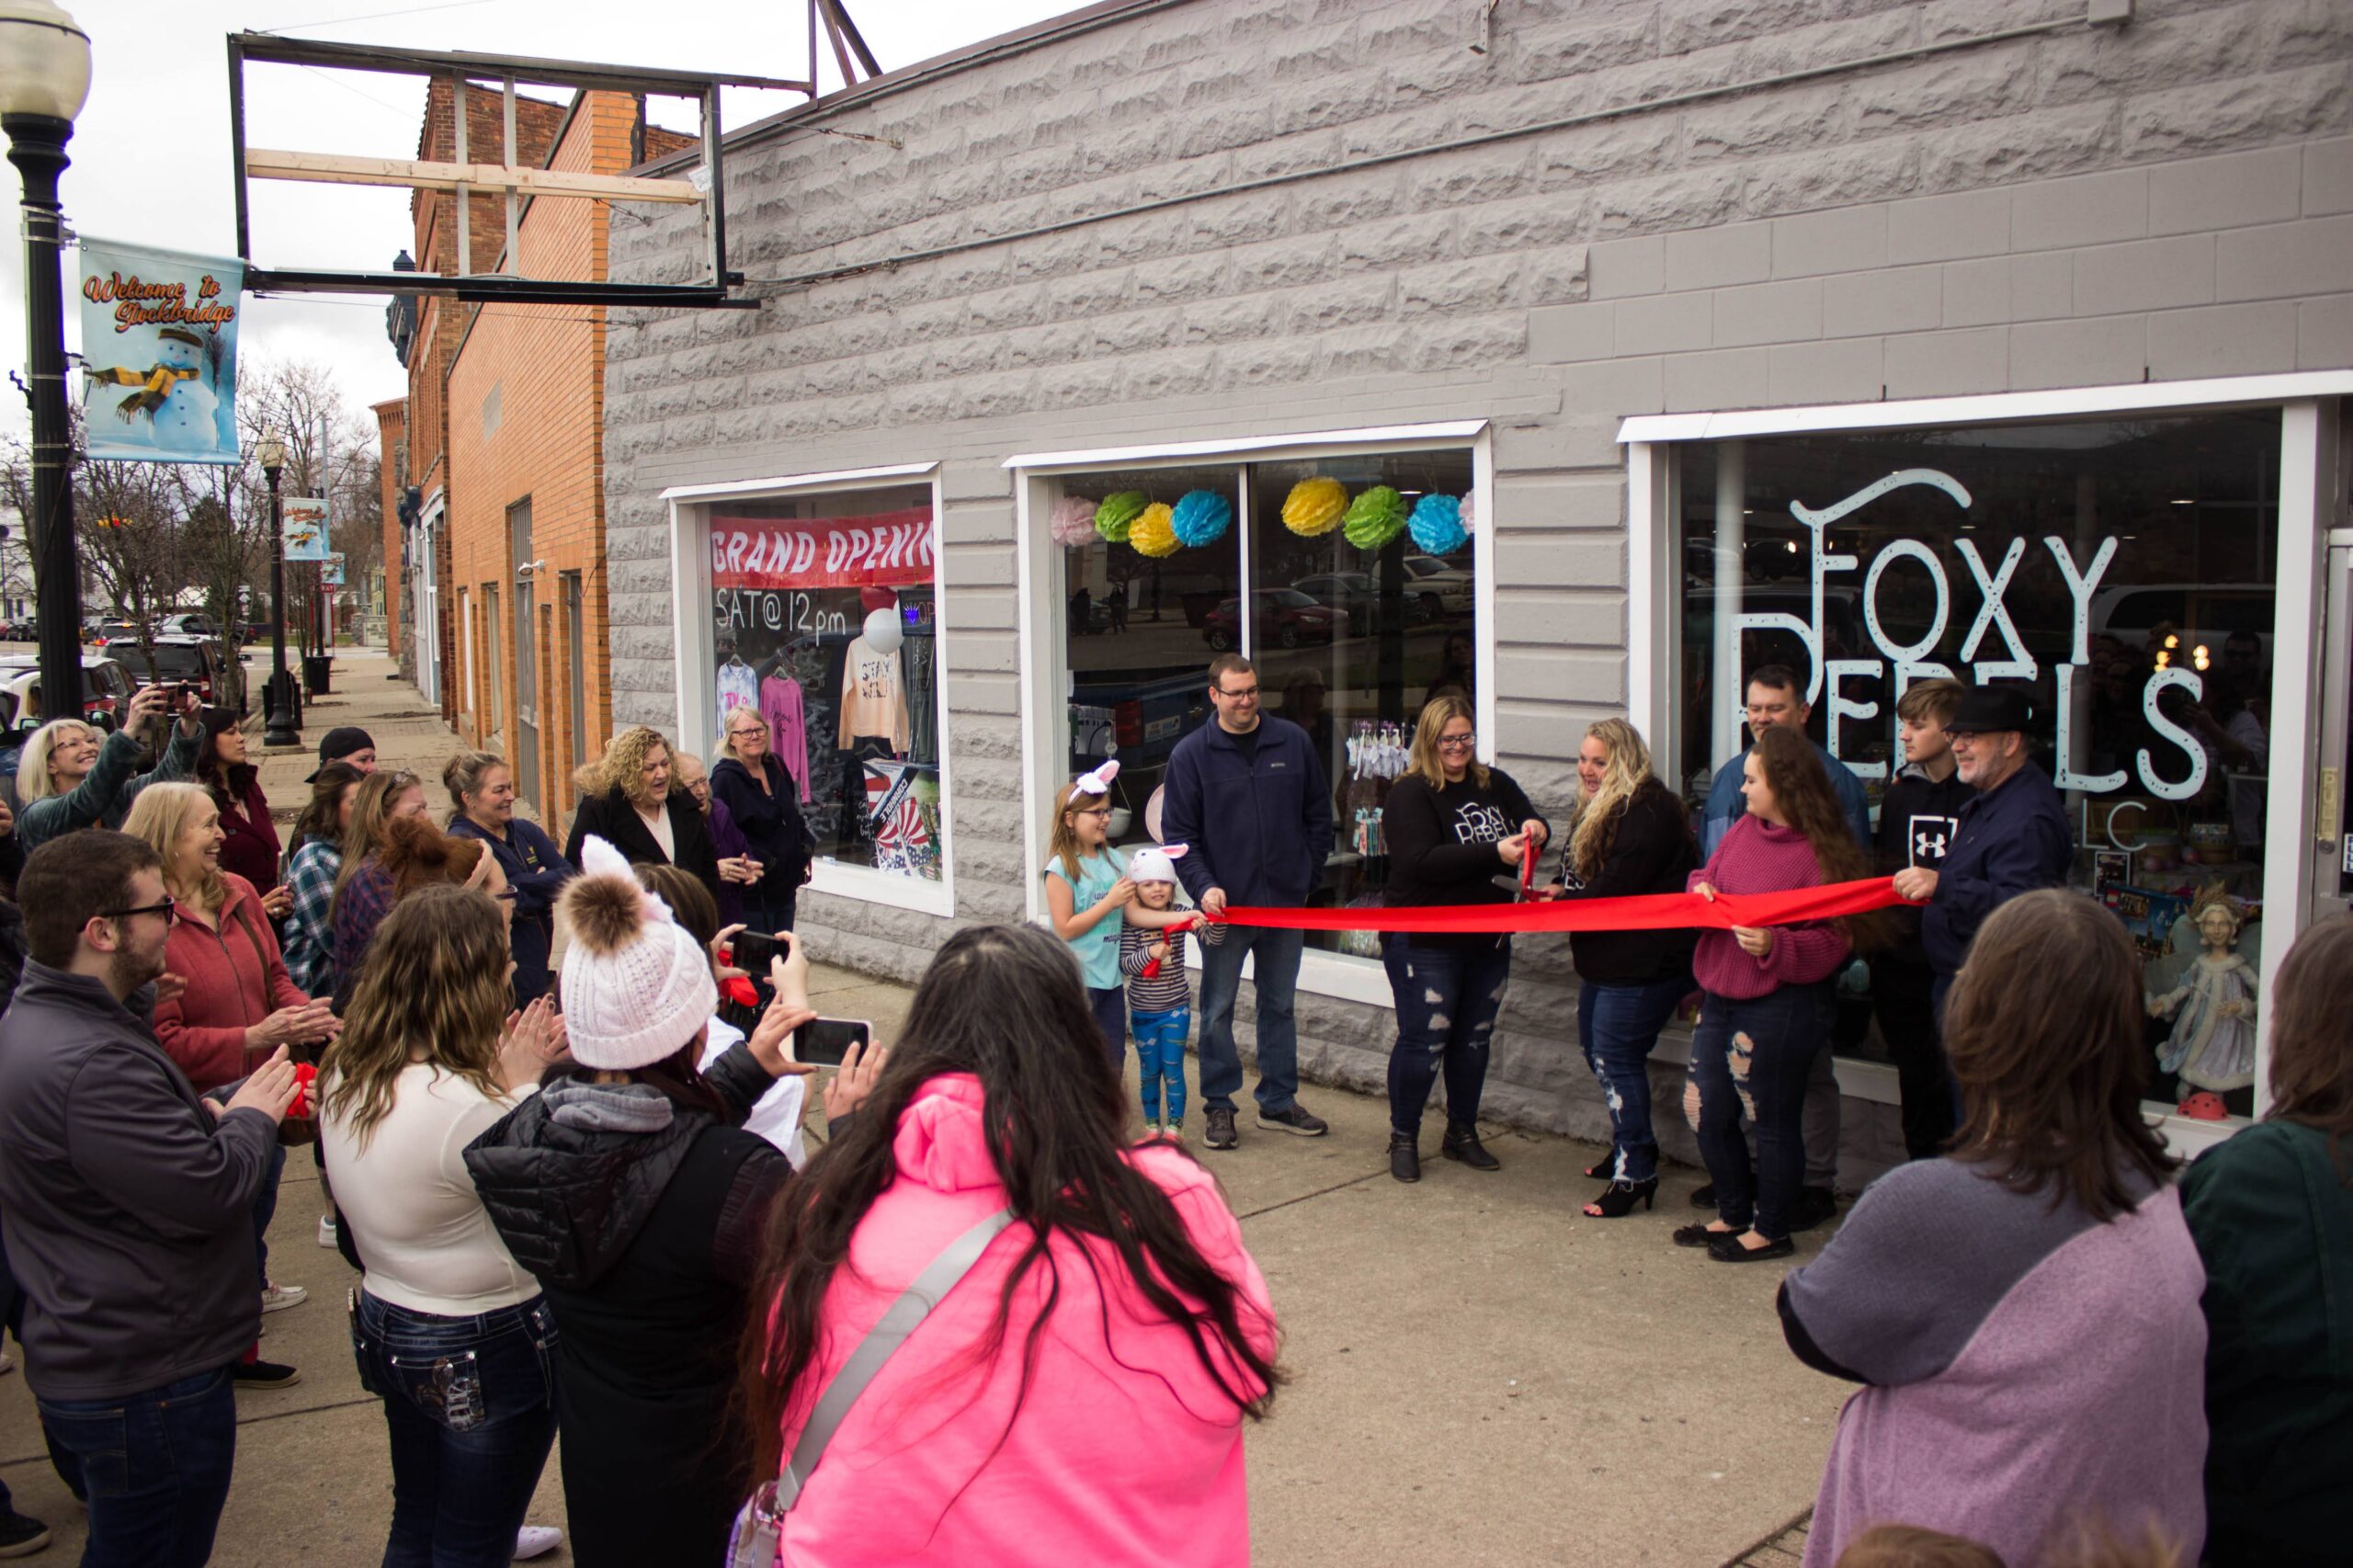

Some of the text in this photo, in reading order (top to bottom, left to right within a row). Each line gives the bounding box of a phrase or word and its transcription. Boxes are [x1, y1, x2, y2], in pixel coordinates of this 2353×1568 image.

[84, 271, 222, 303] Welcome to
[115, 298, 235, 333] Stockbridge
[711, 531, 816, 574] GRAND
[1790, 468, 2119, 665] FOXY
[1732, 612, 2207, 800] RELS
[879, 778, 908, 824] CORNHOLE
